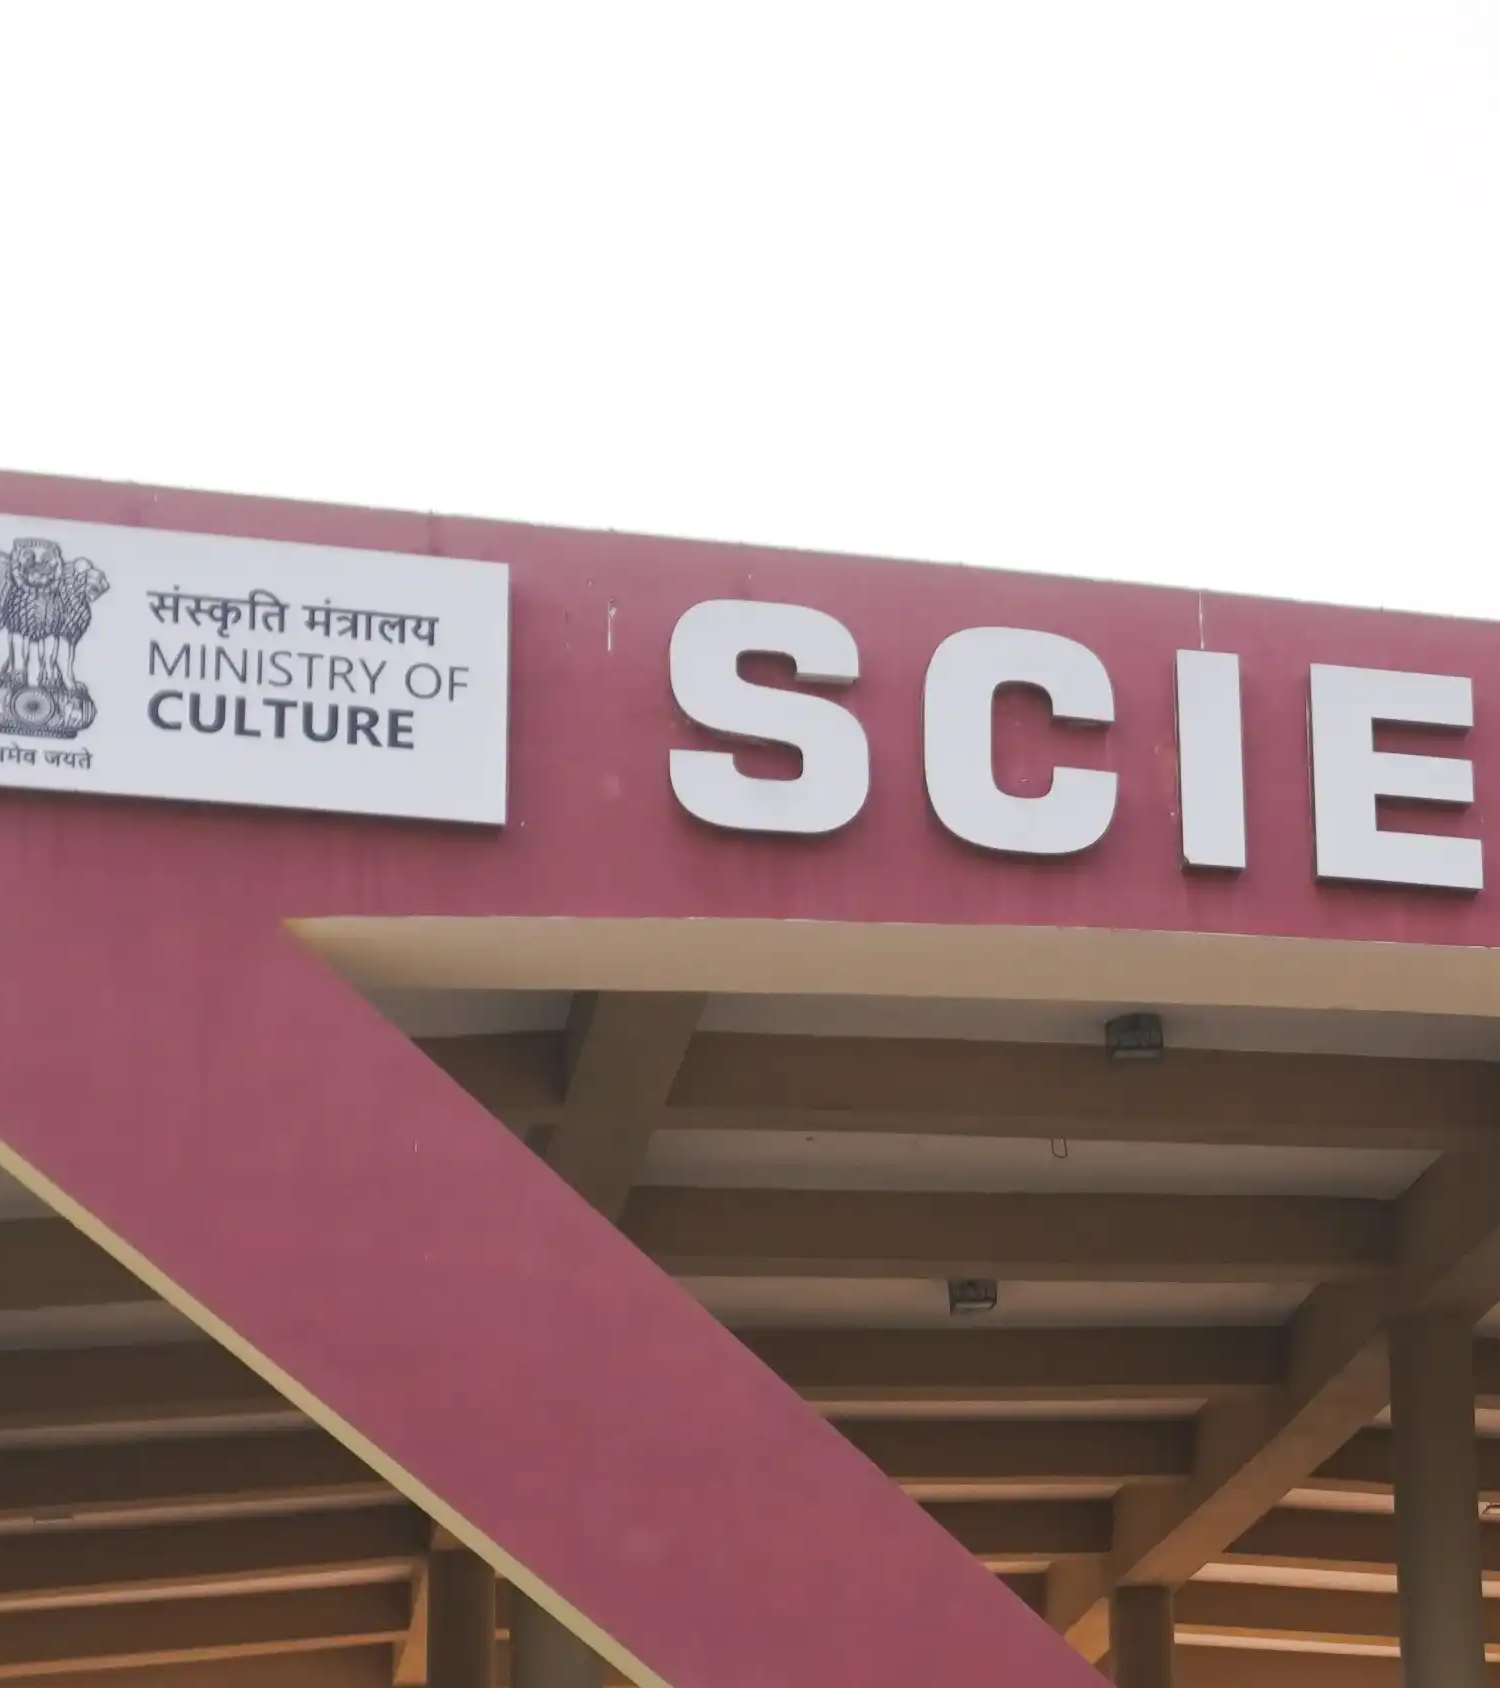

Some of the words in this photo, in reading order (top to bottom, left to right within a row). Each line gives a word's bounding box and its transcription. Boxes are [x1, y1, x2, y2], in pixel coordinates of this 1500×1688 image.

[147, 585, 290, 639] संस्कृति
[302, 597, 440, 647] मंत्रालय
[148, 640, 388, 695] MINISTRY
[405, 662, 471, 702] OF
[147, 690, 416, 750] CULTURE
[44, 746, 94, 771] जयते
